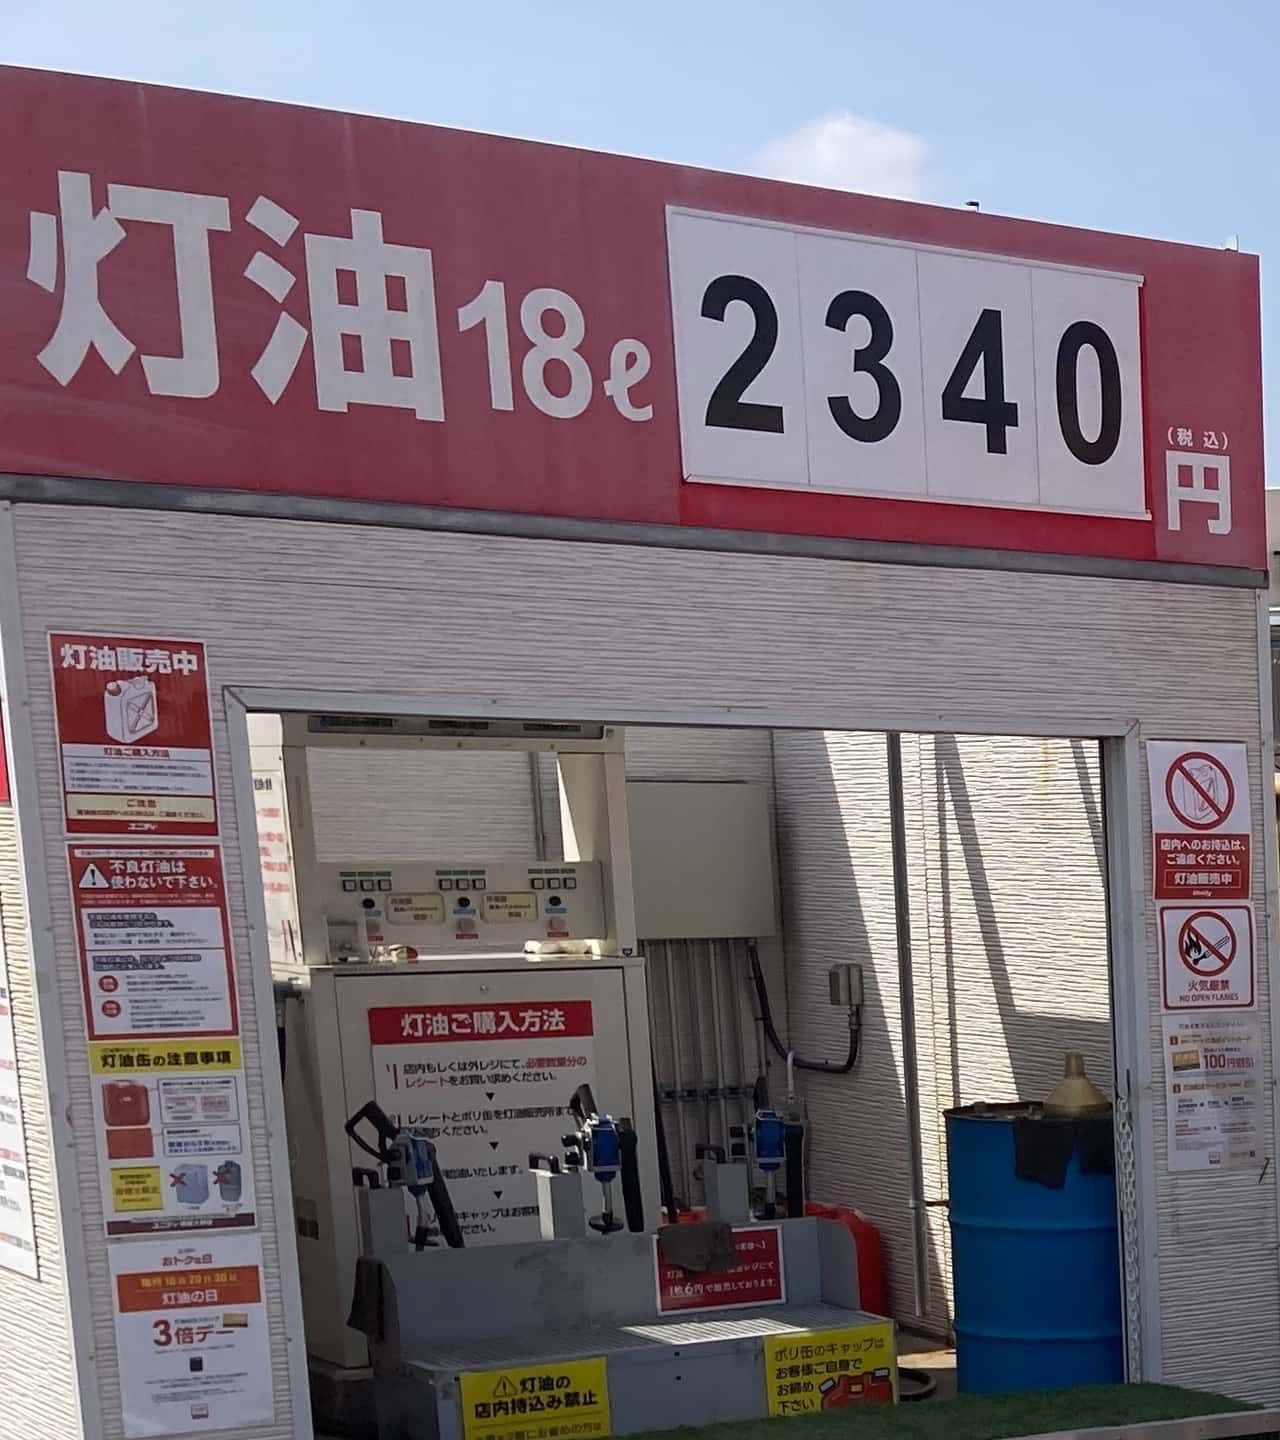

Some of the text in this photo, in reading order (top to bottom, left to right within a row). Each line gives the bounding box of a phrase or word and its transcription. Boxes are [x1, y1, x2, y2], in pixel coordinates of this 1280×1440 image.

[26, 170, 446, 423] 灯油
[700, 275, 1123, 466] 2340
[1165, 450, 1232, 536] 円
[61, 643, 198, 675] 灯油販売中
[109, 860, 186, 874] 不良灯油は
[1174, 872, 1233, 885] 灯油販売中
[1188, 980, 1230, 992] 火気厳禁
[1191, 993, 1211, 1001] OPEN
[401, 1009, 566, 1037] 灯油ご購入方法
[102, 1050, 231, 1068] 灯油缶の注意事項
[443, 1164, 523, 1180] 給油いたします。
[161, 1289, 218, 1305] 灯油の日
[153, 1319, 235, 1347] 3倍デー
[774, 1337, 884, 1362] ポリ缶のキャップは
[519, 1376, 571, 1394] 灯油の
[475, 1389, 599, 1419] 店内持込み禁止
[778, 1398, 815, 1414] 下さい
